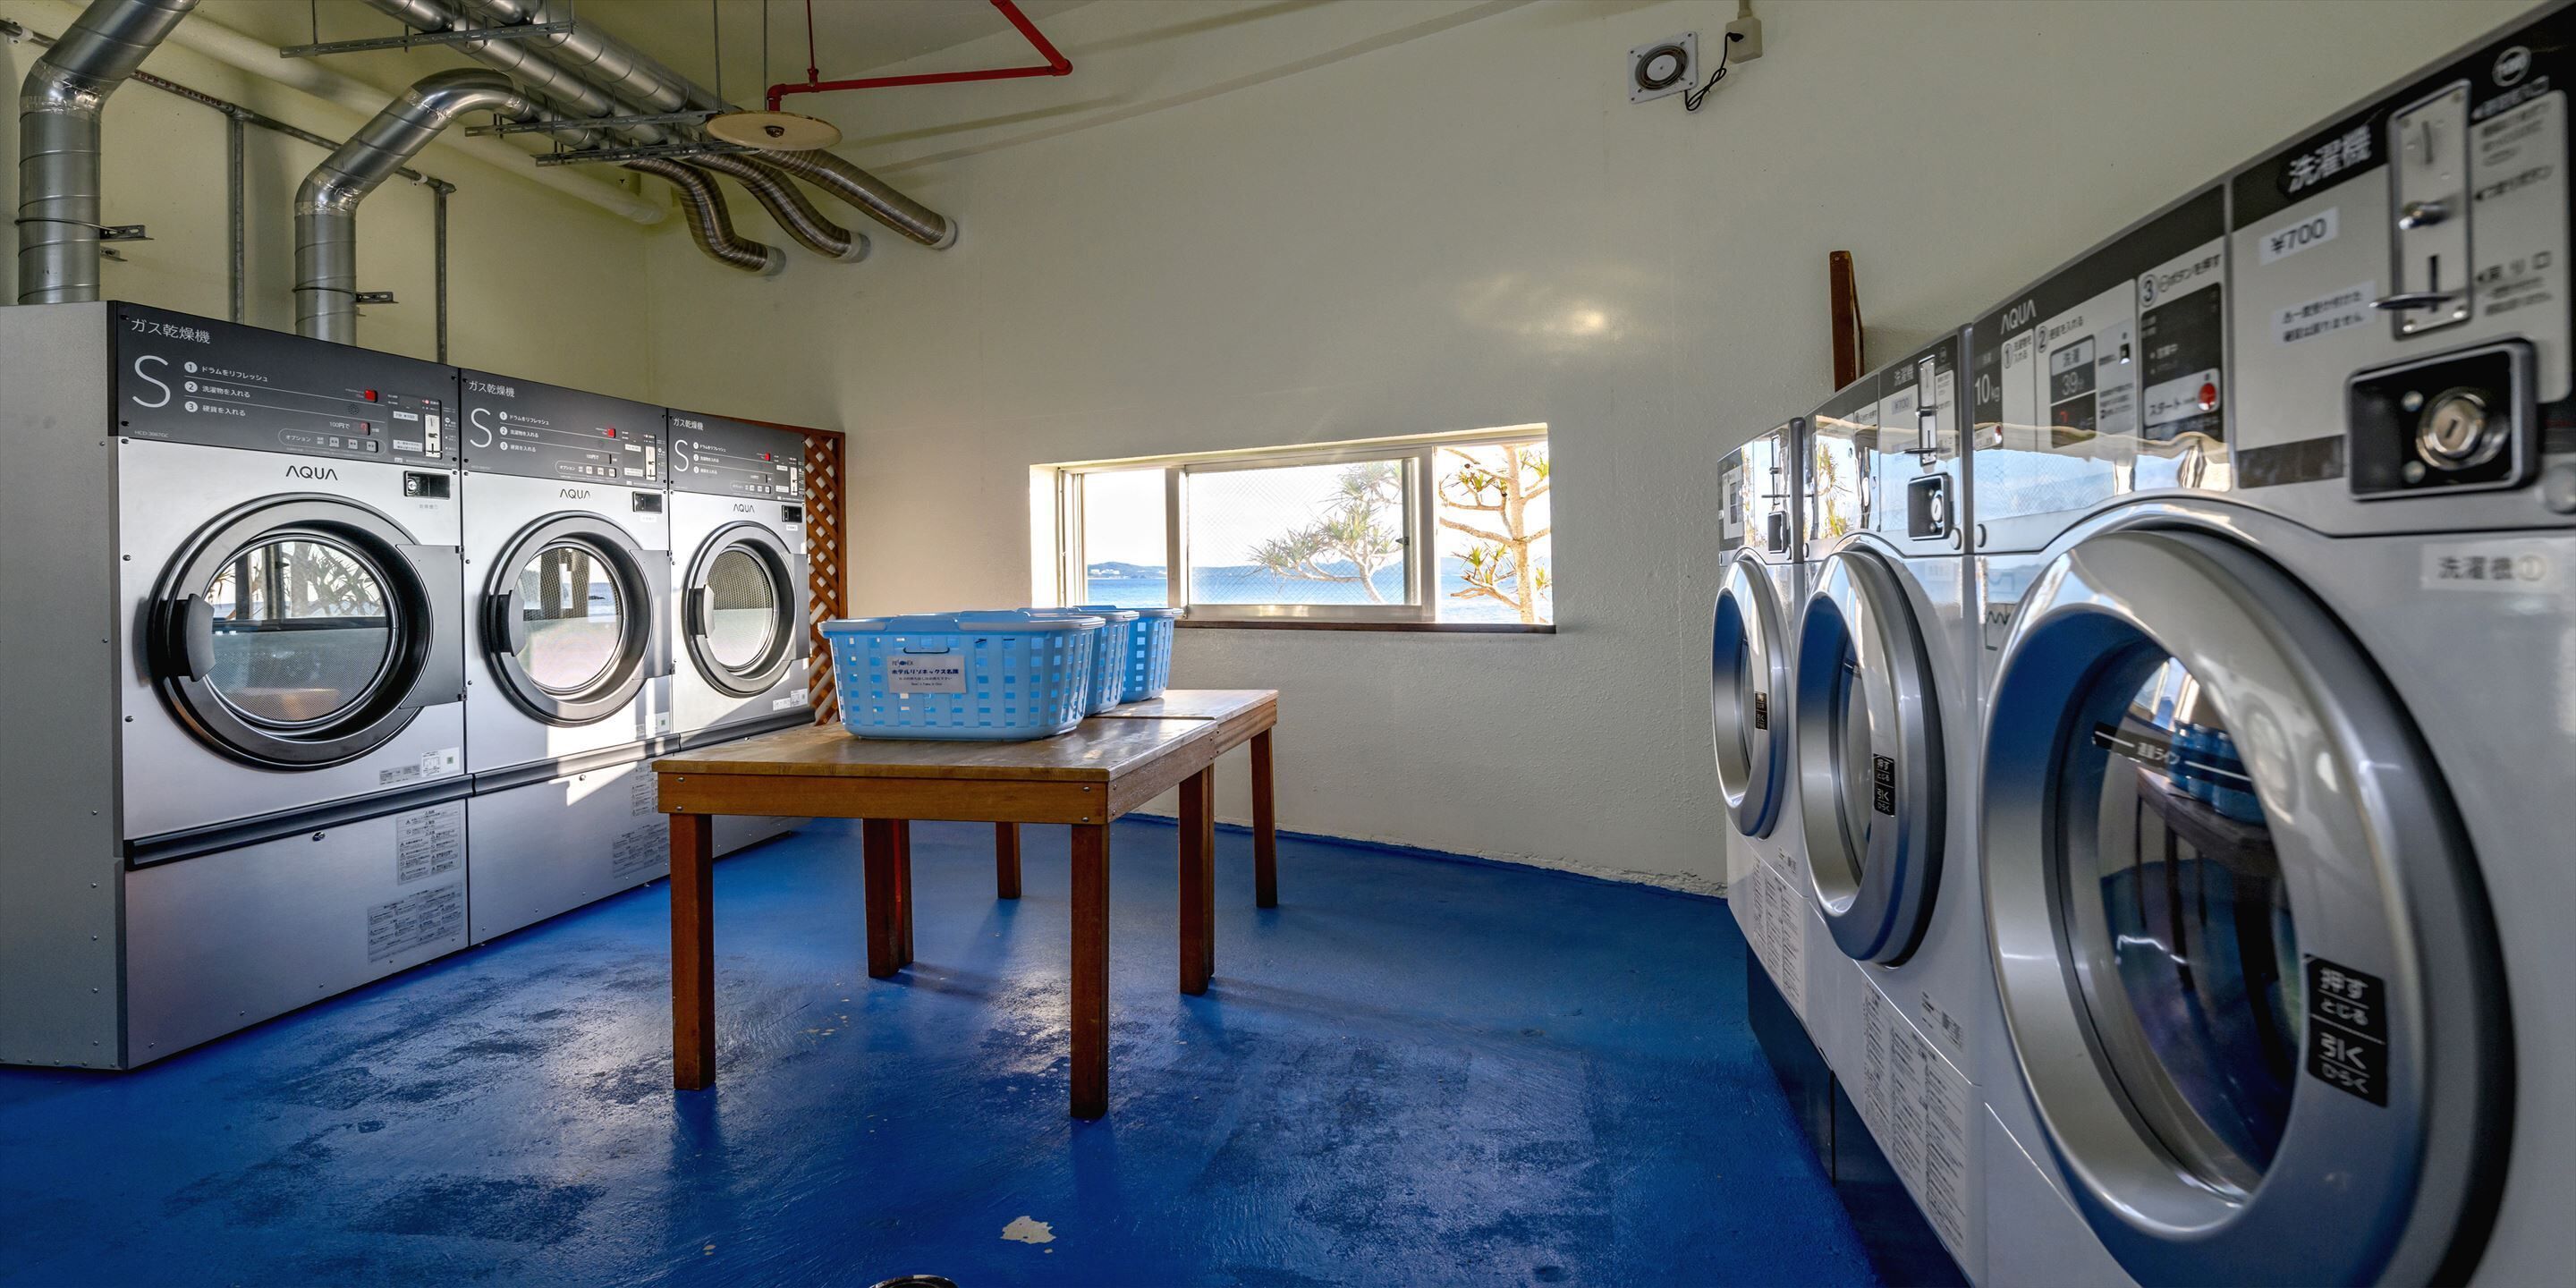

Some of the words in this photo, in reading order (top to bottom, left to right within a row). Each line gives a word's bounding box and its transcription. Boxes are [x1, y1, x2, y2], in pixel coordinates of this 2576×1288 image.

[2287, 123, 2372, 193] 洗濯機
[2270, 217, 2327, 254] ¥700
[131, 318, 211, 344] ガス乾燥機
[2001, 299, 2037, 335] AQUA
[131, 354, 172, 409] S
[201, 366, 268, 383] ドラムをリフレッシュ
[201, 385, 251, 399] 洗濯物を入れる
[468, 380, 516, 398] ガス乾燥機
[202, 404, 246, 418] 硬貨を入れる
[673, 418, 704, 431] ガス乾燥機
[285, 434, 311, 443] オプション
[470, 407, 493, 448] S
[674, 439, 690, 472] S
[285, 465, 339, 480] AQUA
[559, 487, 591, 499] AQUA
[733, 503, 756, 514] AQUA
[2319, 967, 2369, 1000] 押す
[2320, 997, 2369, 1027] とじる
[2319, 1031, 2368, 1071] 引く
[2321, 1062, 2369, 1095] ひらく
